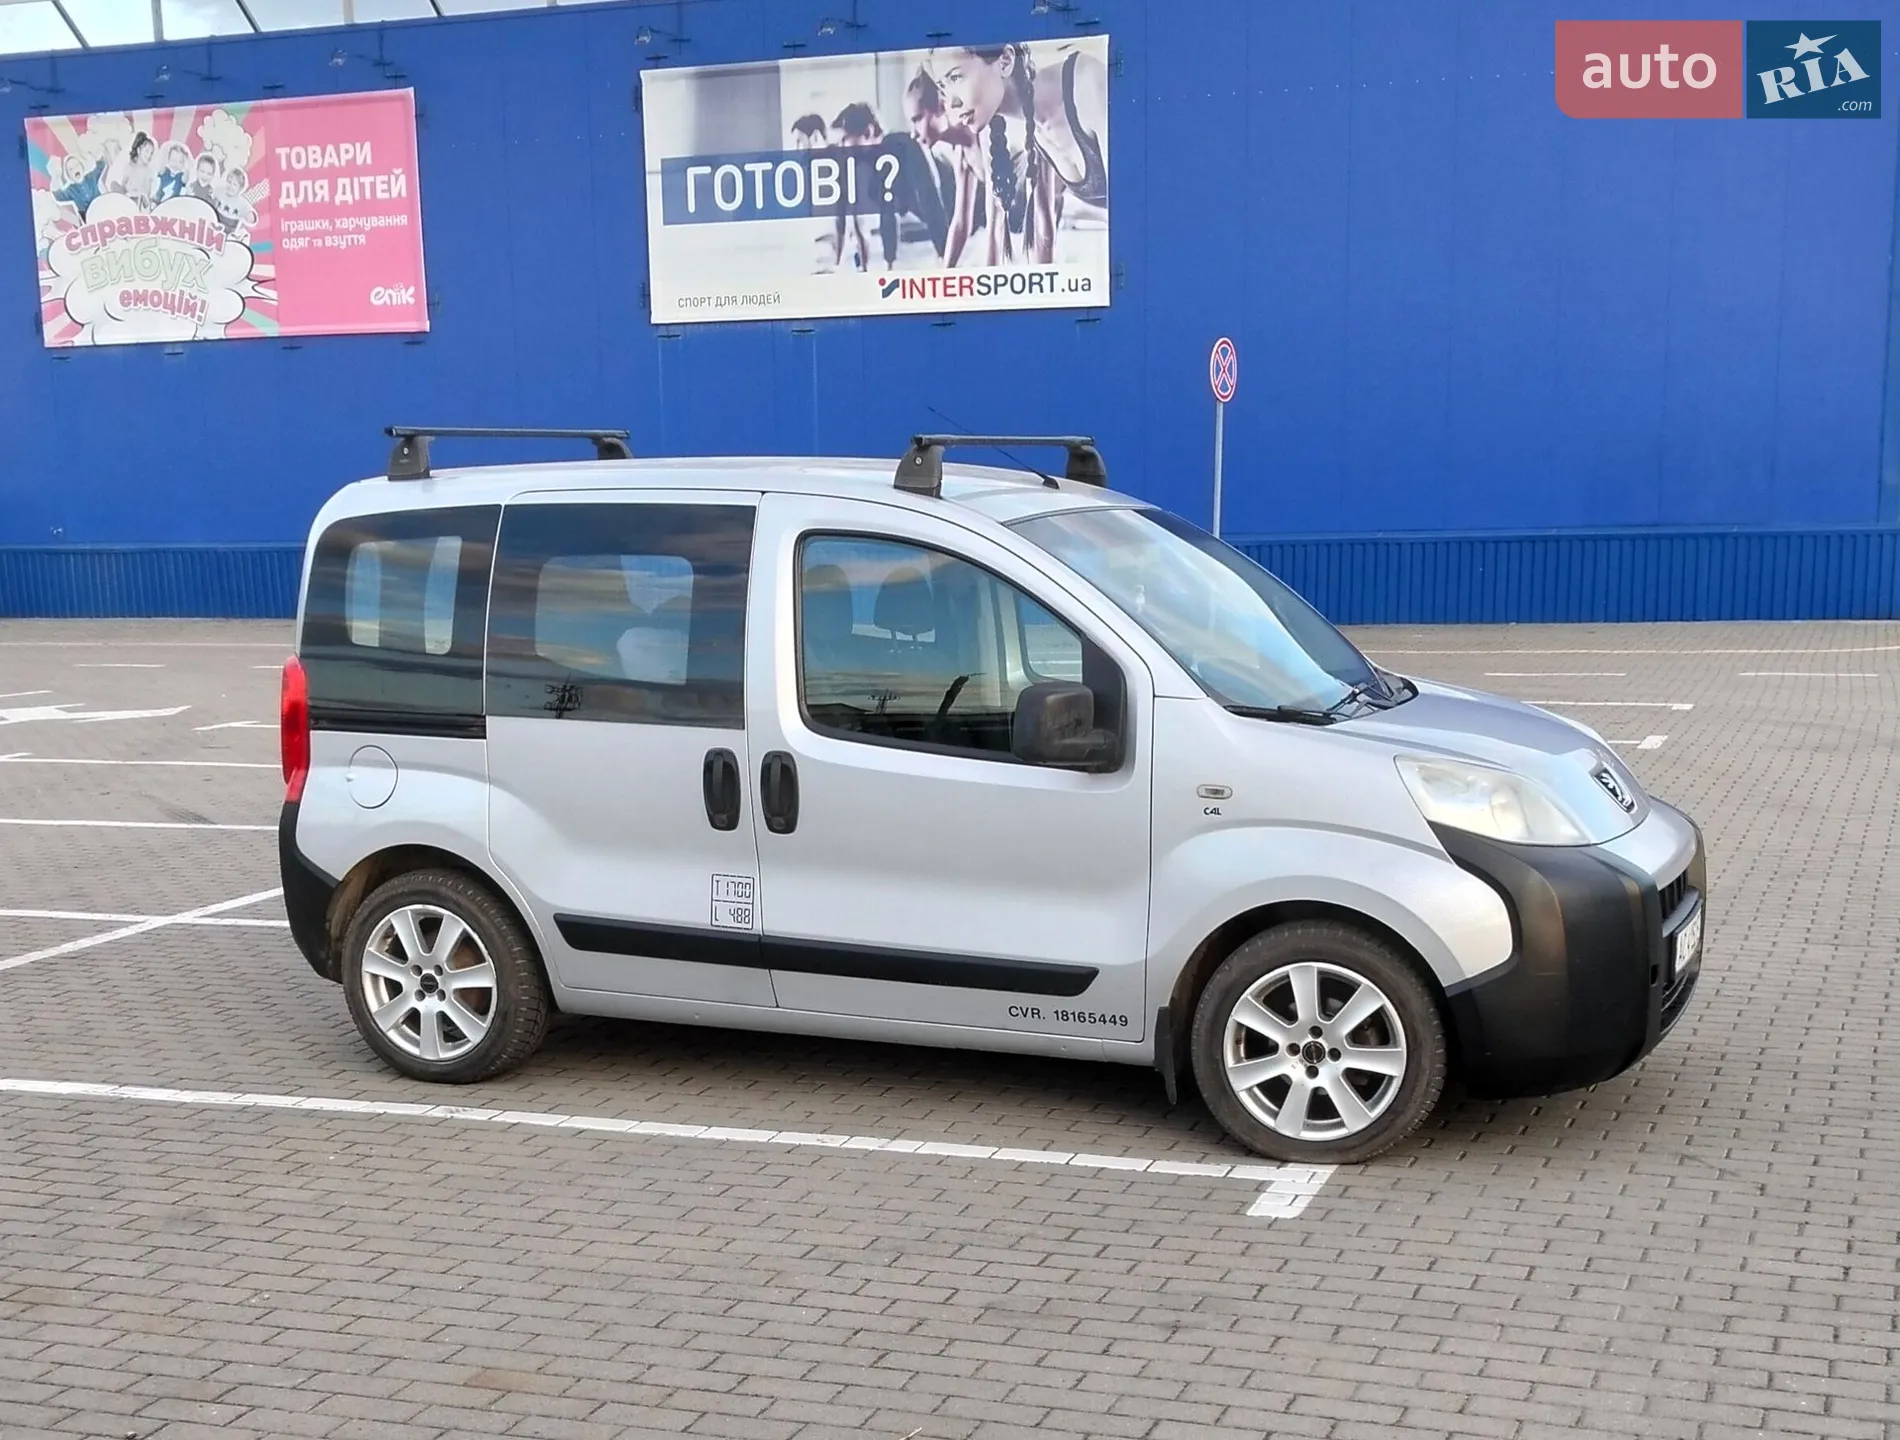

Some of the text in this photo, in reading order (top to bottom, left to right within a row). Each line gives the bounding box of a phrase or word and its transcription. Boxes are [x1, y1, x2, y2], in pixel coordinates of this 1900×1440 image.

[275, 141, 373, 171] ТОВАРИ
[279, 168, 407, 209] ДЛЯ ДІТЕЙ
[685, 156, 856, 213] ГОТОВІ
[64, 215, 226, 253] справжній
[335, 214, 408, 235] харчування
[282, 236, 310, 250] одяг
[325, 233, 366, 249] взуття
[81, 238, 211, 295] вибух
[901, 271, 1092, 299] INTERSPORT.ua
[119, 289, 207, 322] емоцій!
[677, 291, 781, 308] СПОРТ ДЛЯ ЛЮДЕЙ
[726, 881, 751, 899] 1700
[728, 907, 751, 924] 488
[1008, 1005, 1129, 1027] CVR. 18165449
